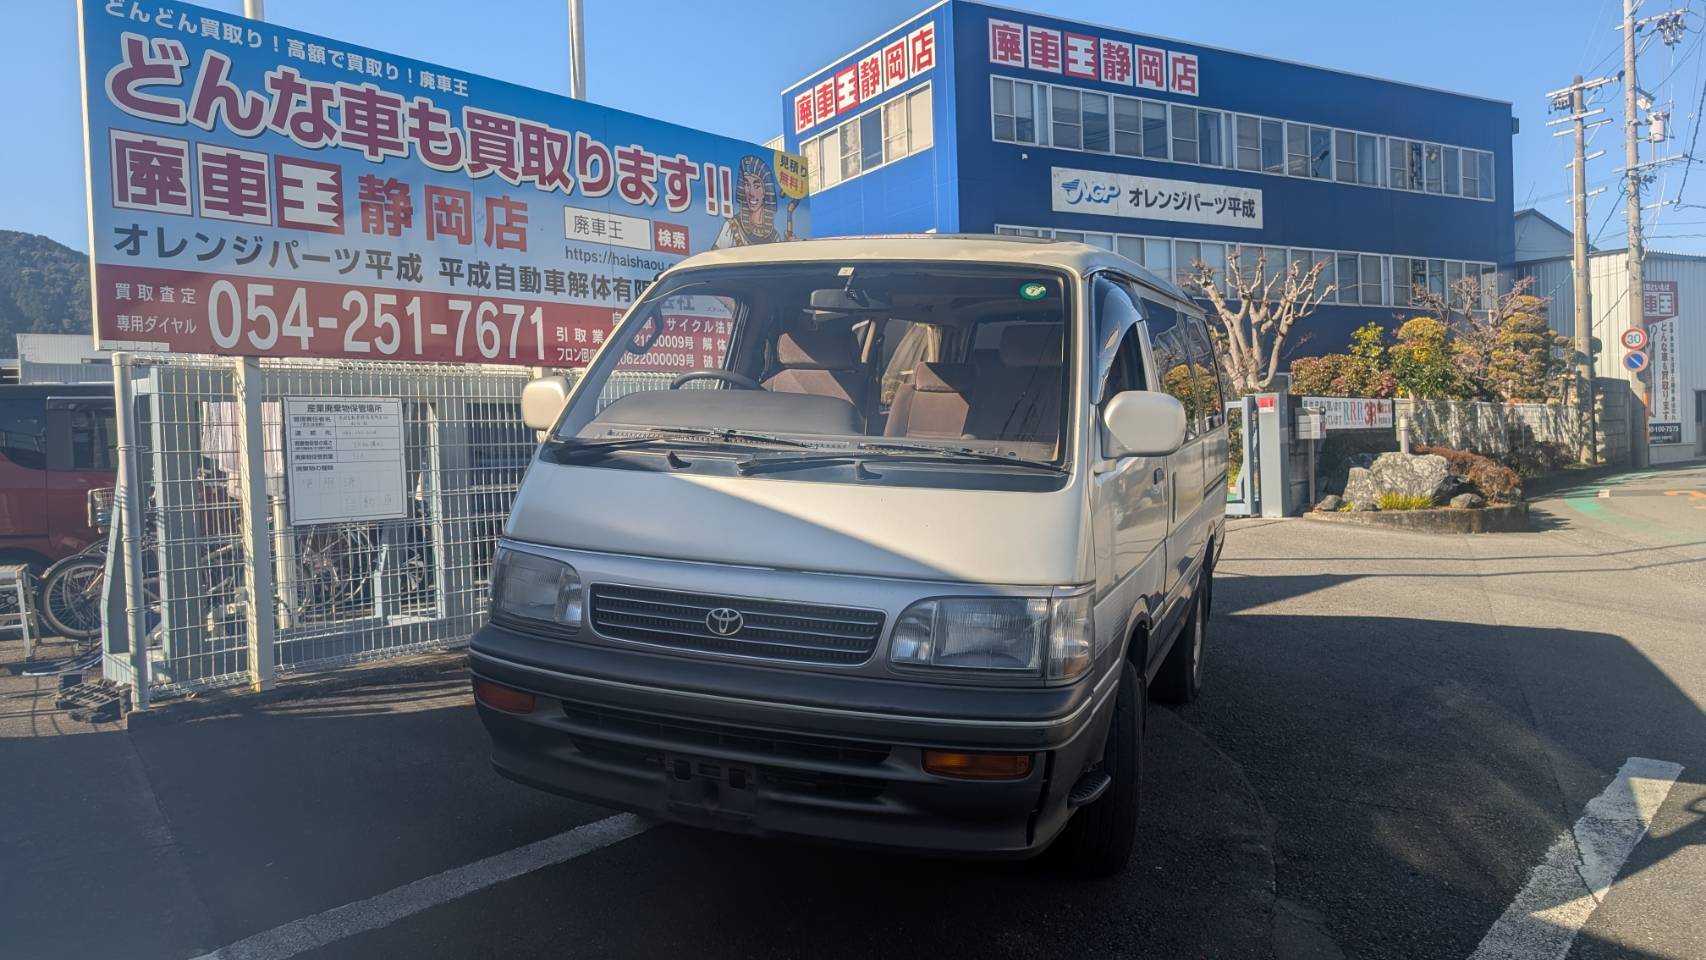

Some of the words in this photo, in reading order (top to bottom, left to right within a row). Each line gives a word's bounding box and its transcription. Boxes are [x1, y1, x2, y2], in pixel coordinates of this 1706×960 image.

[1128, 187, 1256, 219] オレンジパーツ平成
[573, 215, 624, 240] 廃車王
[657, 227, 687, 250] 検索
[113, 223, 423, 284] オレンジパーツ平成
[115, 282, 197, 304] 買取査定
[116, 314, 197, 335] 専用ダイヤル
[208, 279, 546, 361] 054-251-7671
[1627, 333, 1641, 345] 30
